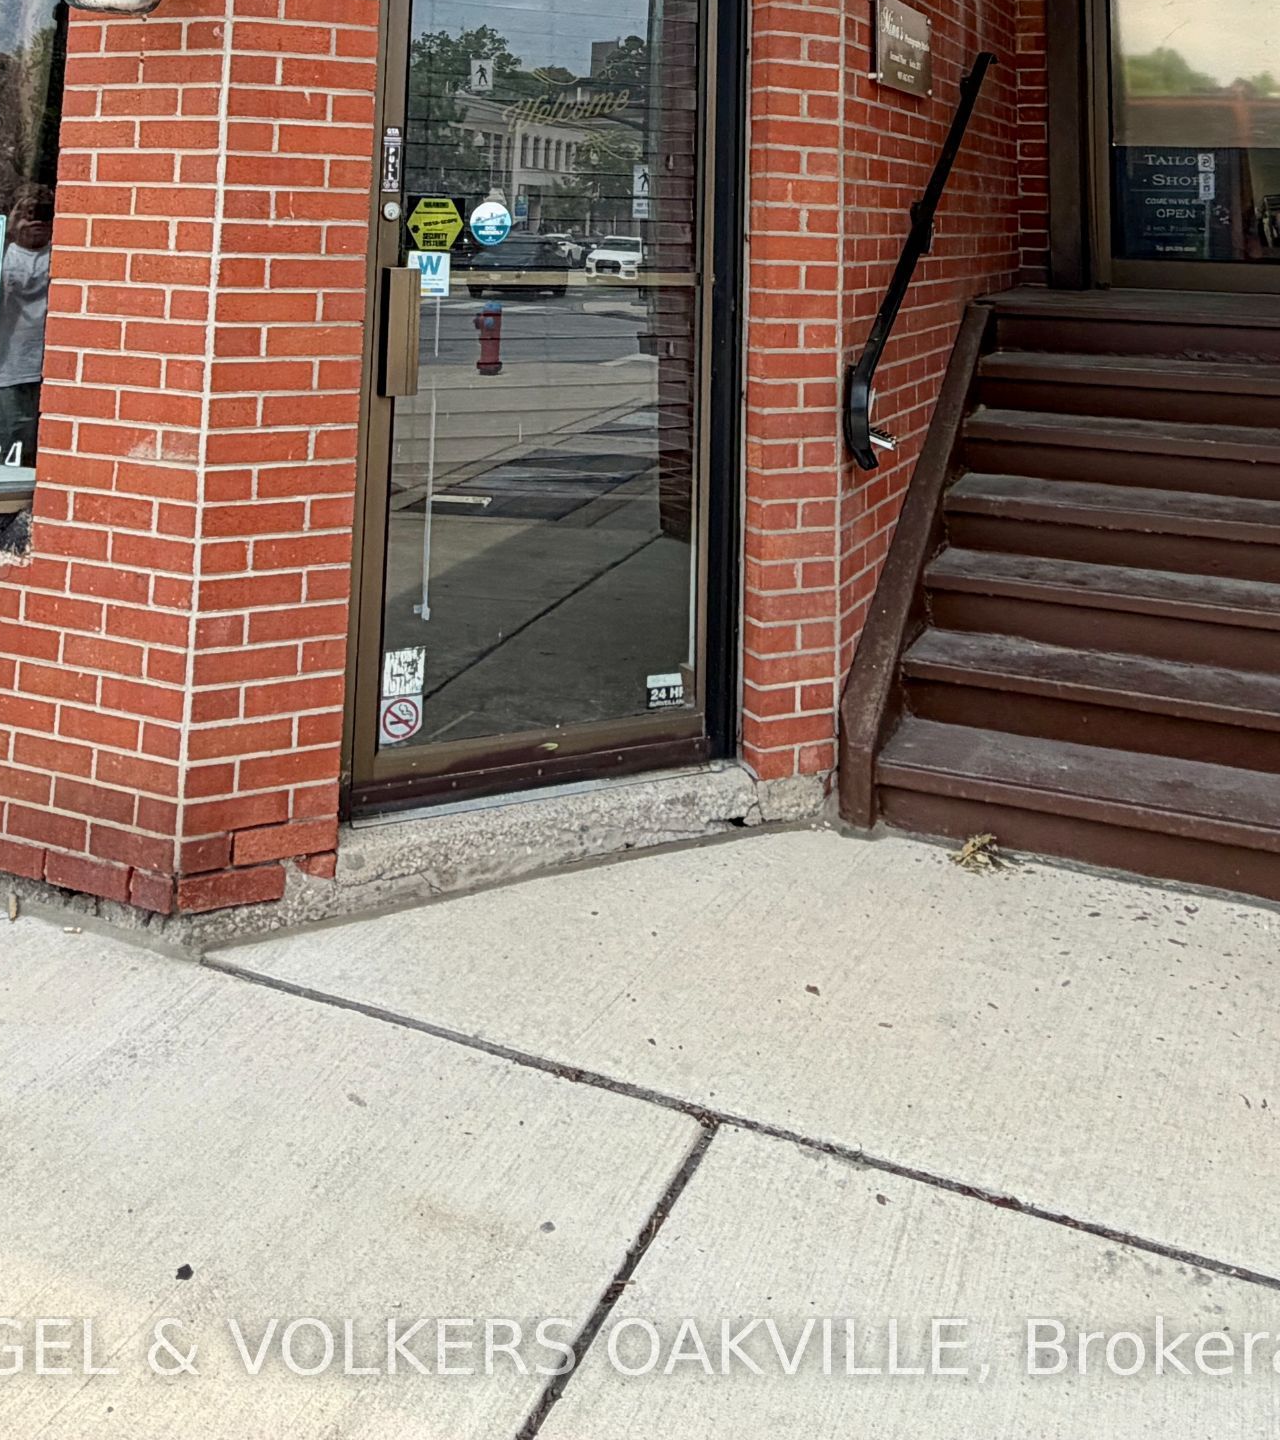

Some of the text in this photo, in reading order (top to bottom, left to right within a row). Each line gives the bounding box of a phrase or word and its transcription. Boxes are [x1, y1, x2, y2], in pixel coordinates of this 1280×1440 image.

[501, 89, 630, 133] Welcome
[1144, 153, 1199, 166] TAILO
[1156, 208, 1196, 219] OPEN
[650, 688, 667, 700] 24
